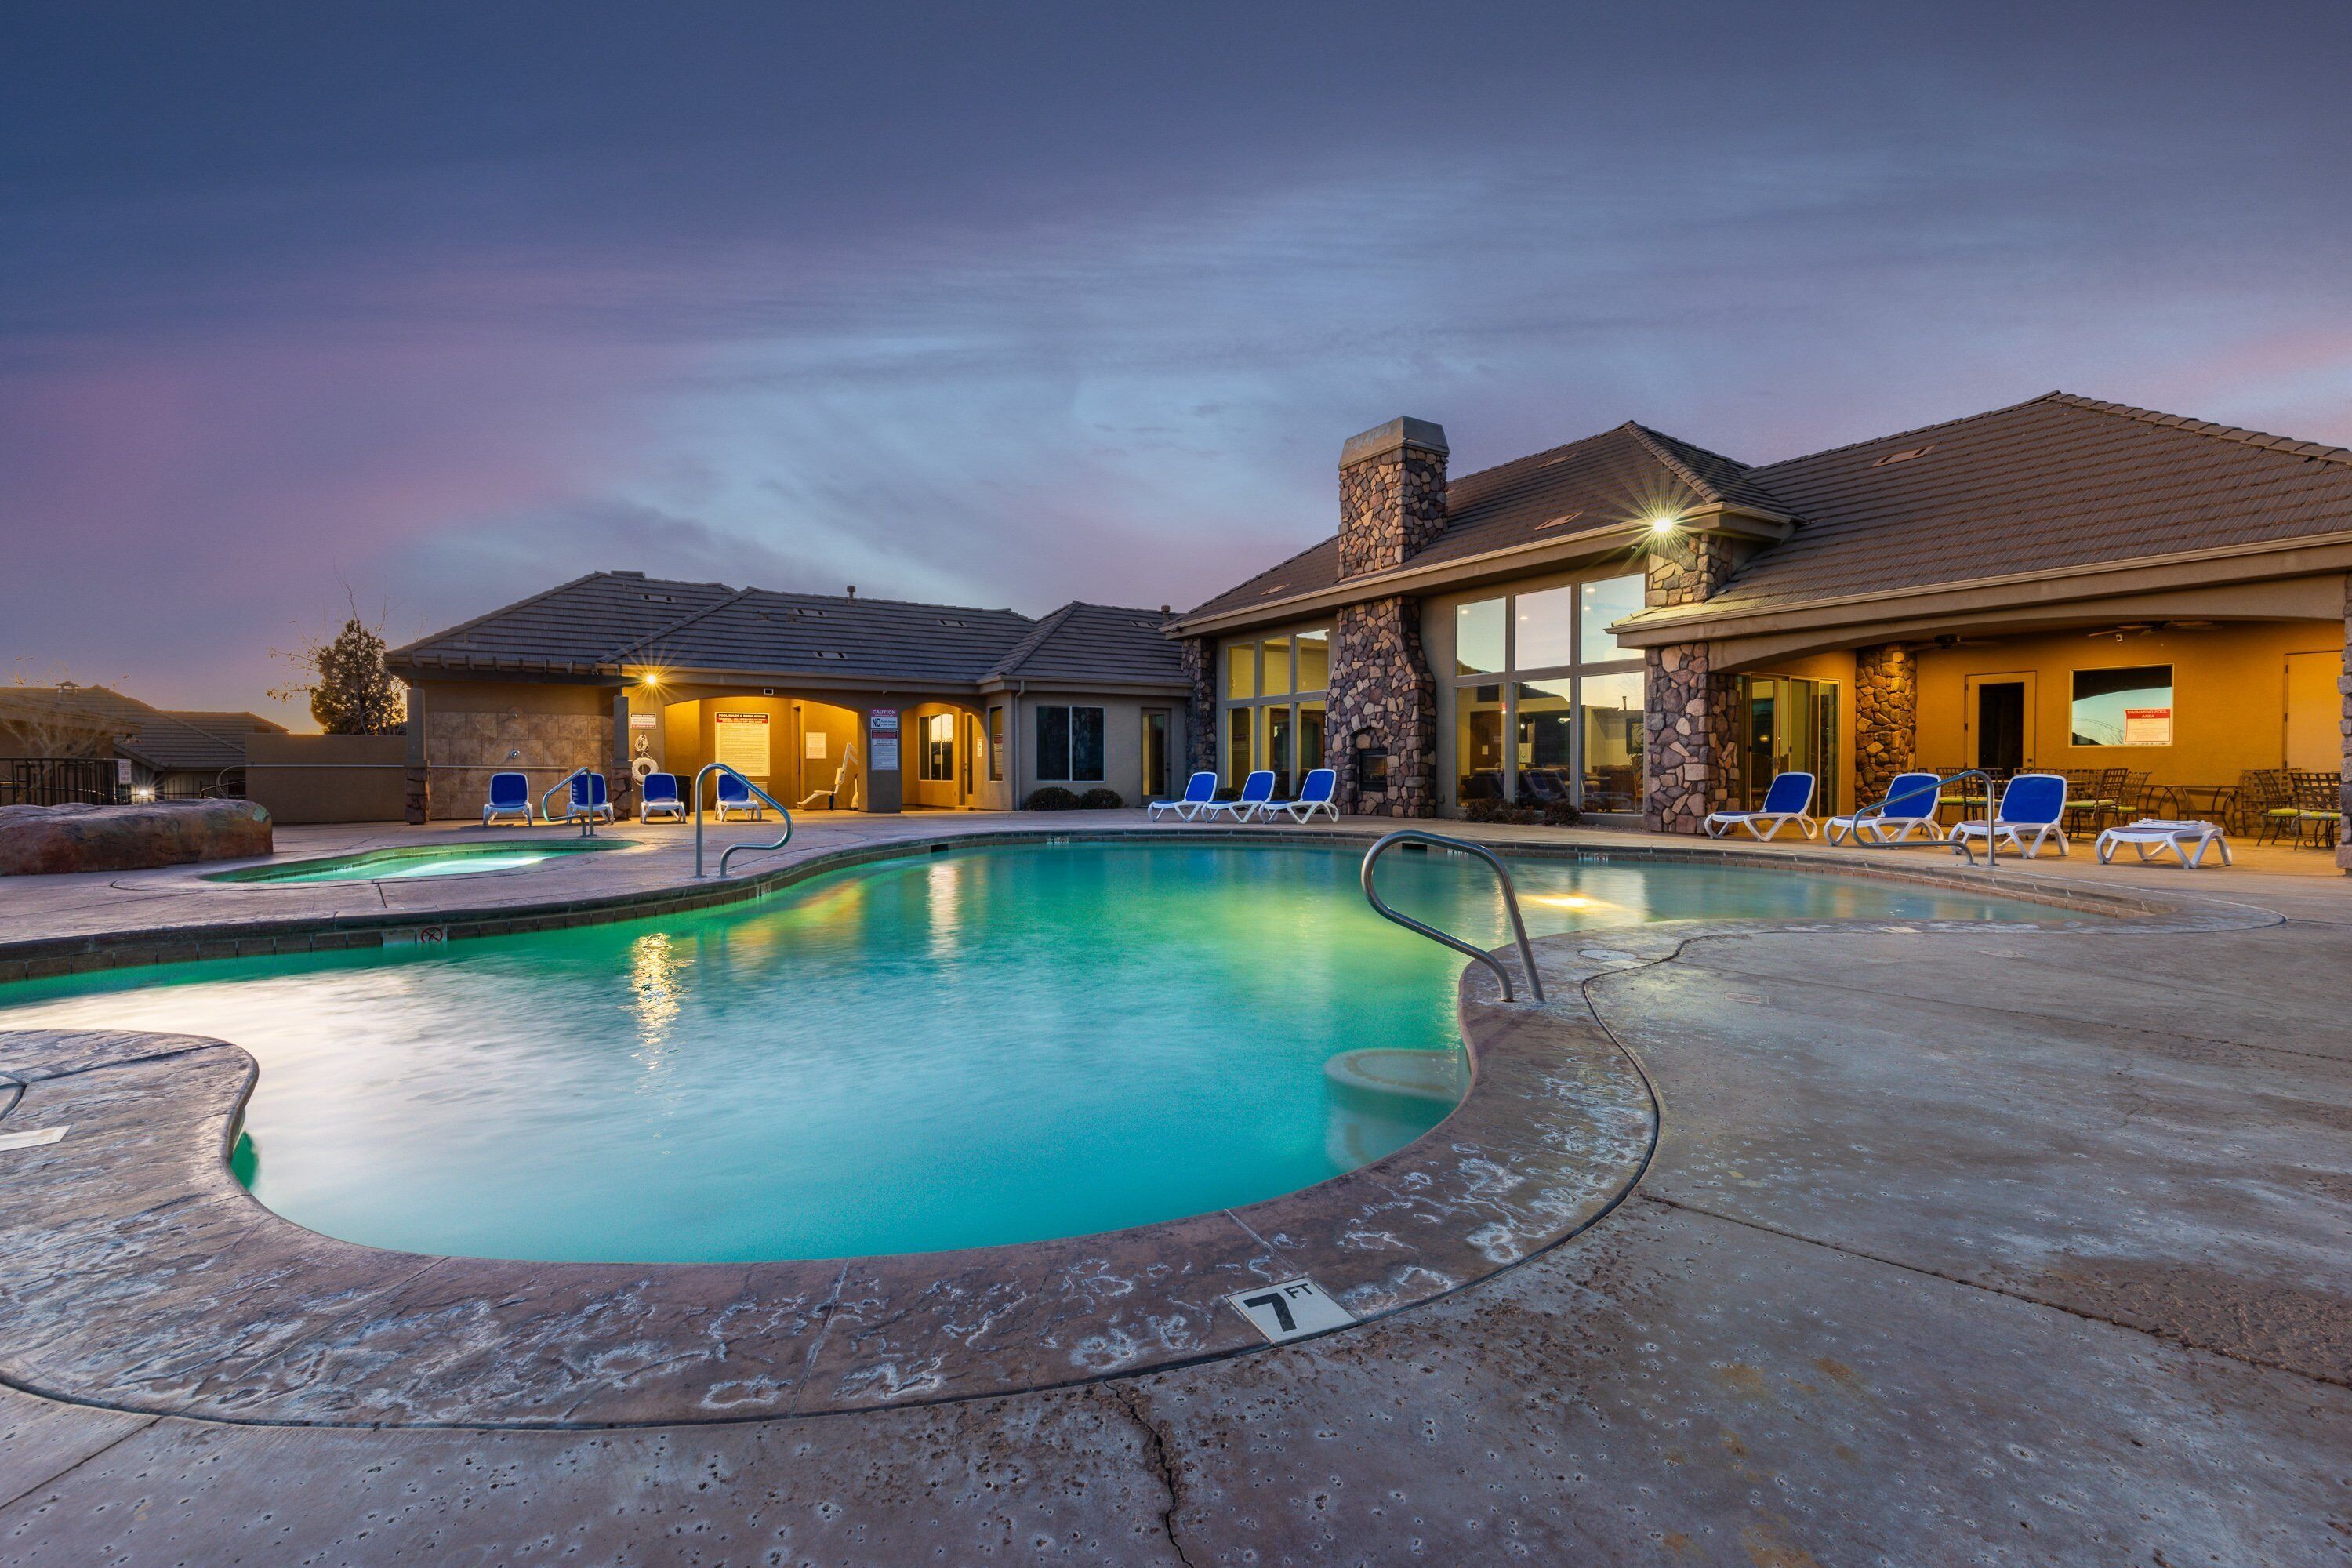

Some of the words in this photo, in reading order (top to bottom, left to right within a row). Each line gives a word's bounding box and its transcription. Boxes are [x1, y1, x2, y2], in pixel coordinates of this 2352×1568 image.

[873, 718, 881, 727] NO
[1242, 1292, 1297, 1332] 7
[1283, 1283, 1314, 1299] FT
